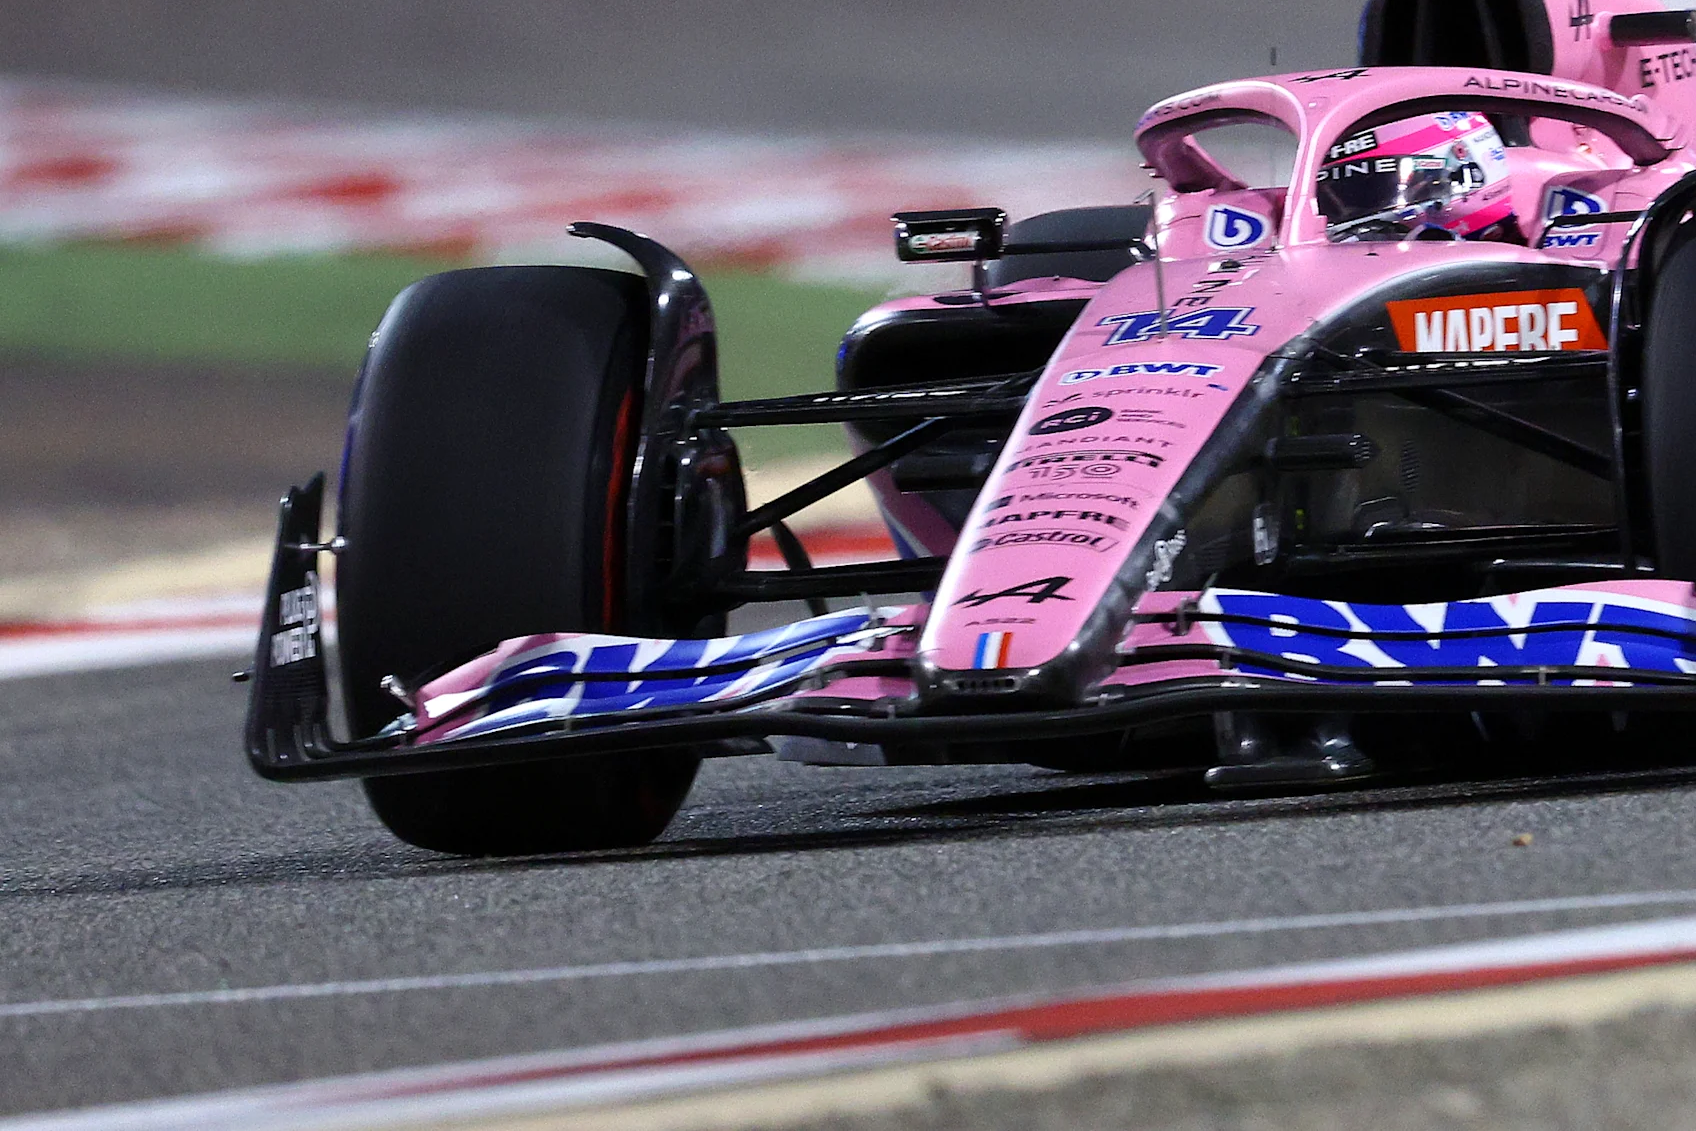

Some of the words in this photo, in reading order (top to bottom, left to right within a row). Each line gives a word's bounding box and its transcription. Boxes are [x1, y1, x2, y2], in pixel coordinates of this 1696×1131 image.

[1096, 307, 1261, 346] 14
[1414, 301, 1579, 352] MAPFRE
[1108, 363, 1220, 377] BWT
[1092, 386, 1204, 398] sprinklr
[1019, 492, 1139, 509] Microsoft
[995, 531, 1101, 547] Castrol
